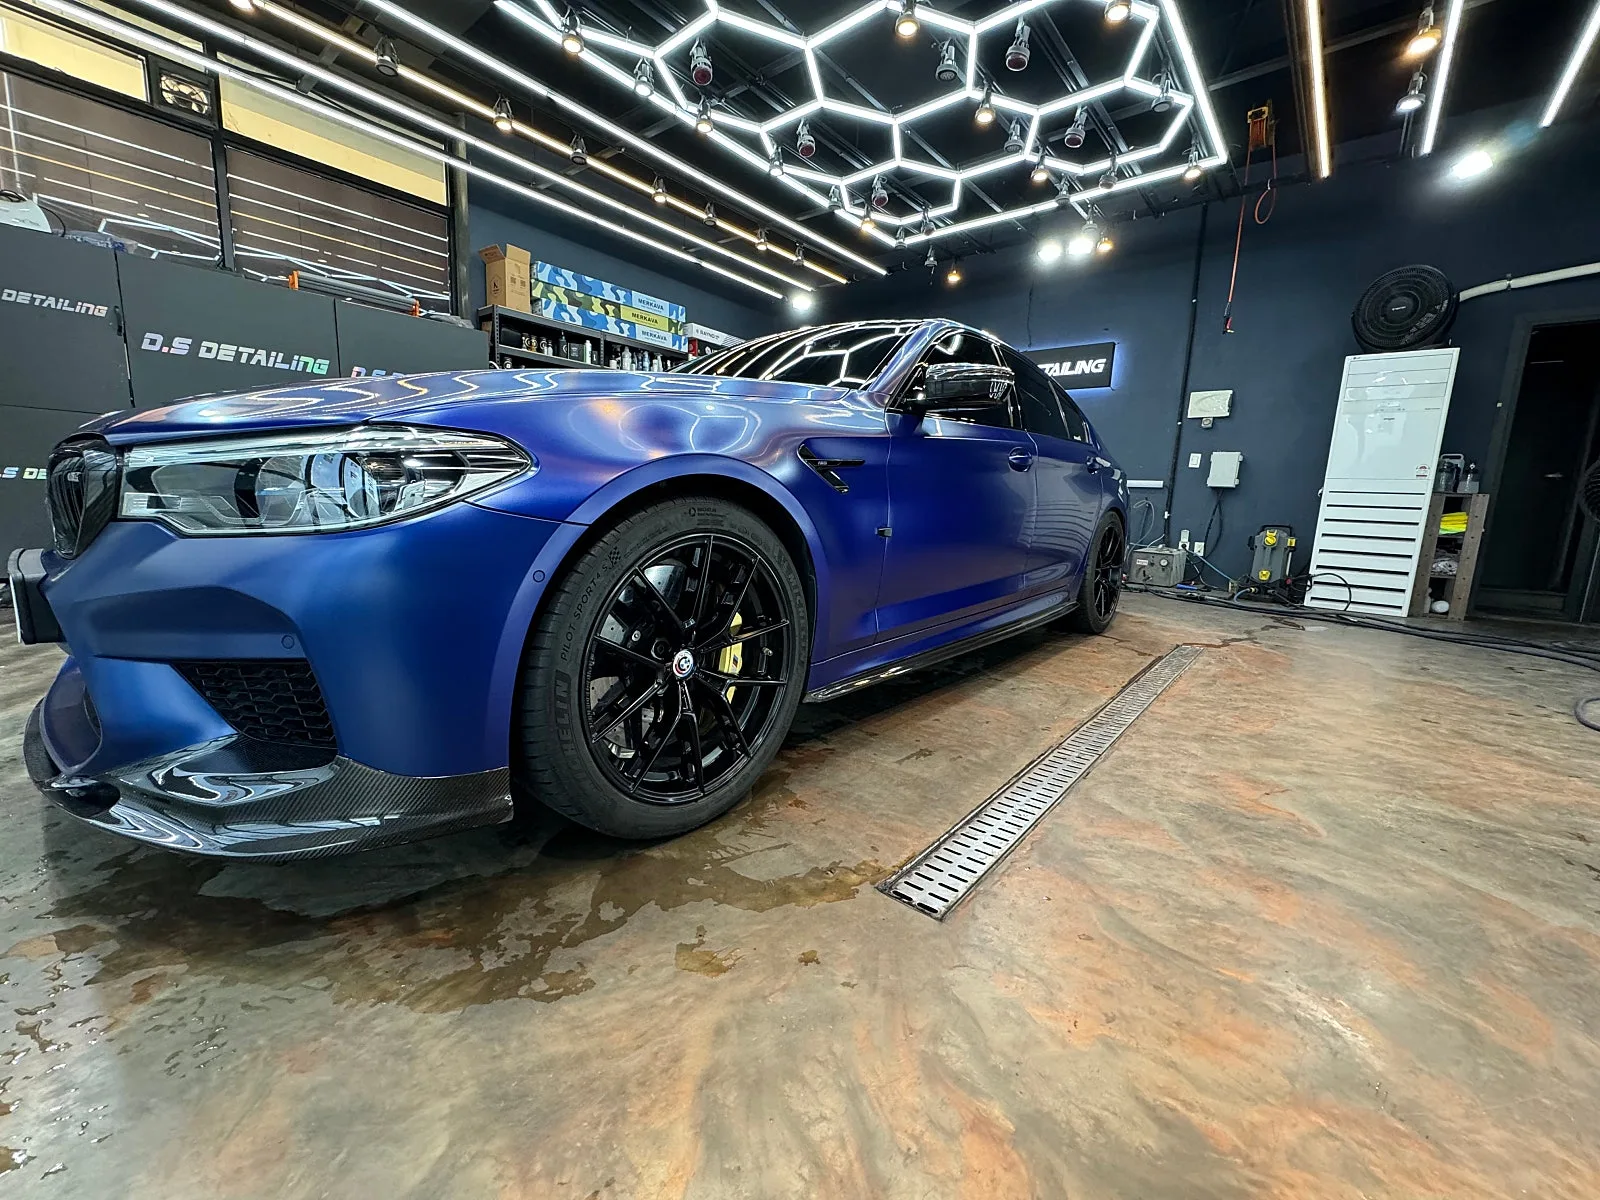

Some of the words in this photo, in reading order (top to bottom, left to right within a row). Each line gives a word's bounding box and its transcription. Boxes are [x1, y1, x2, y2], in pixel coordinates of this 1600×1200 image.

[637, 298, 665, 311] MERKAVA
[631, 312, 659, 325] MERKAVA
[641, 330, 668, 341] MERKAVA
[141, 332, 193, 355] D.S
[560, 623, 577, 662] PILOT
[573, 578, 598, 620] SPORT
